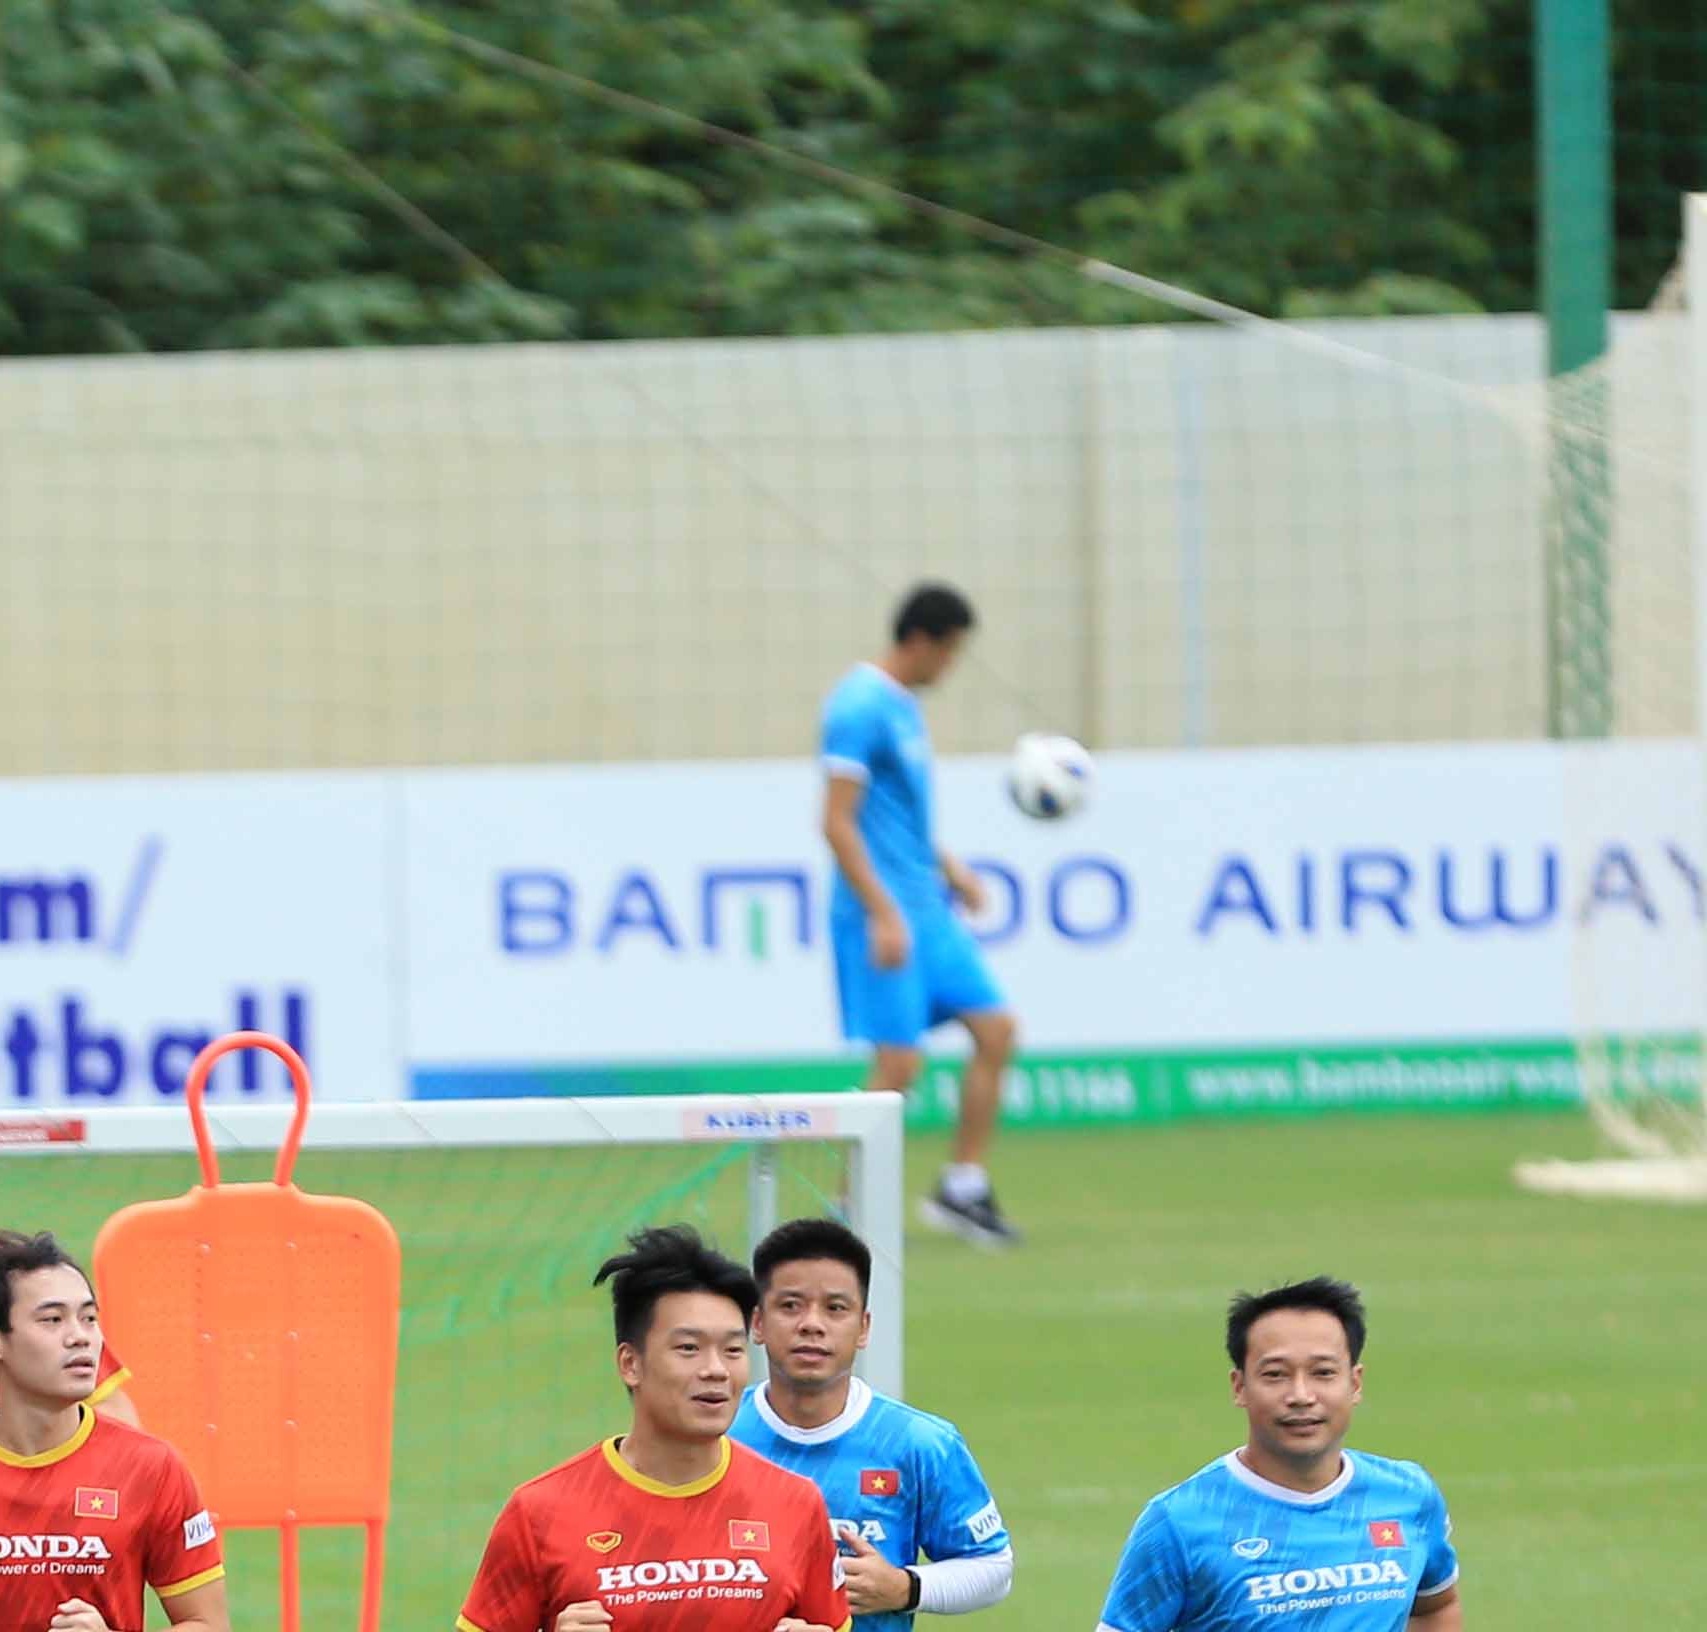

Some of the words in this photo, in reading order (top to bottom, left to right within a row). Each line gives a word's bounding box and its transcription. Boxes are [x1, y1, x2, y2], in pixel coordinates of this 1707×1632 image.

[495, 858, 1135, 958] BAMOO
[31, 1562, 47, 1574] of
[50, 1562, 105, 1576] Dreams
[597, 1558, 768, 1591] HONDA
[1246, 1560, 1408, 1601] HONDA
[605, 1592, 635, 1607] The
[637, 1588, 686, 1603] Power
[689, 1585, 705, 1598] of
[707, 1583, 764, 1600] Dreams
[1257, 1603, 1285, 1615] The
[1287, 1597, 1336, 1611] Power
[1337, 1591, 1354, 1605] of
